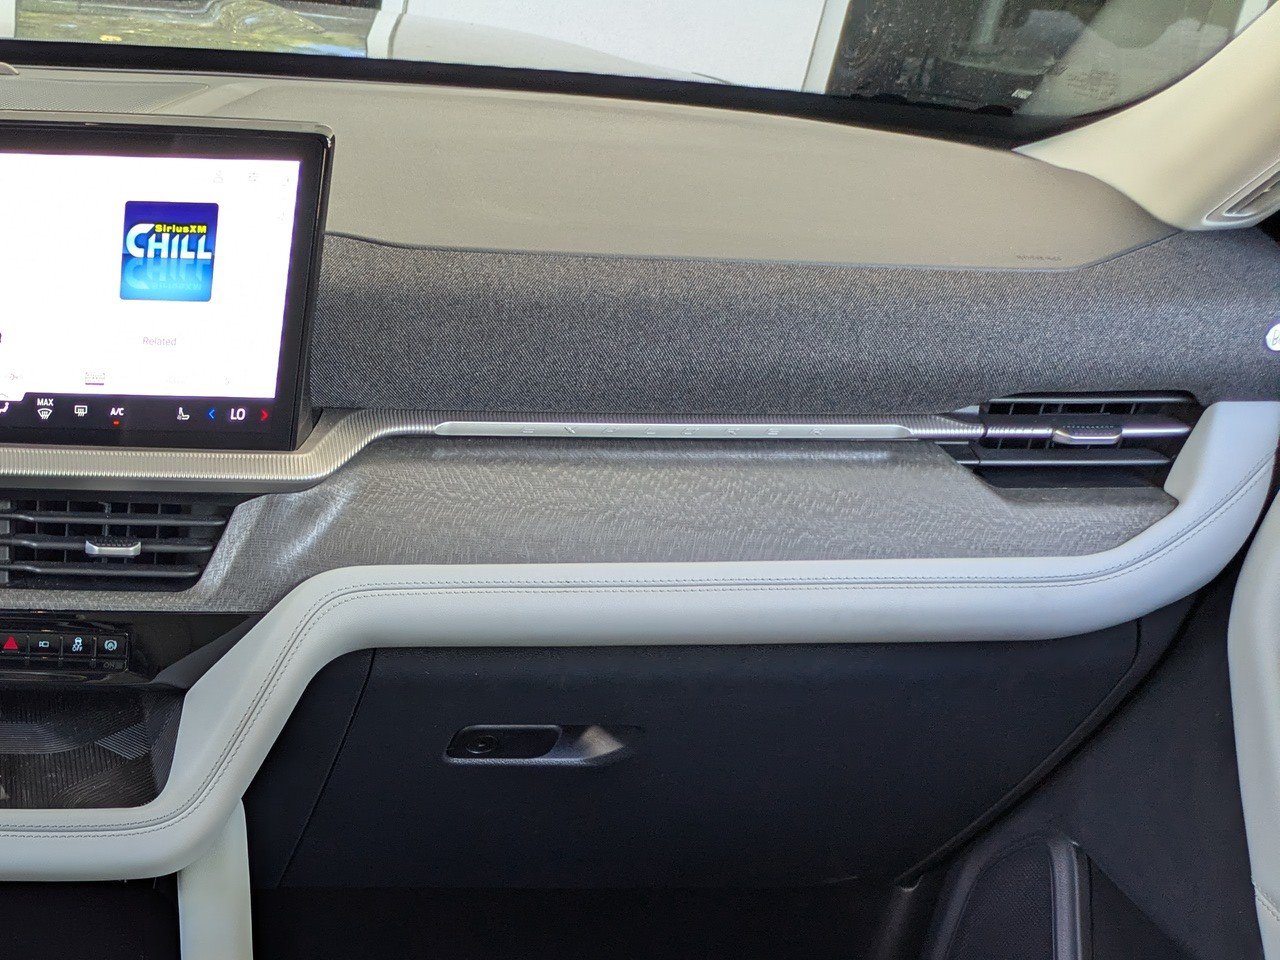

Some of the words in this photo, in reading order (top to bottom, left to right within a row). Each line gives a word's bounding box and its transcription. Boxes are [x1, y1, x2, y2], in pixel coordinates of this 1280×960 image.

[154, 224, 208, 234] SiriusXM
[126, 223, 213, 260] CHILL
[142, 336, 177, 347] Related
[36, 398, 54, 407] MAX
[110, 407, 125, 416] A/C
[230, 408, 246, 420] LO
